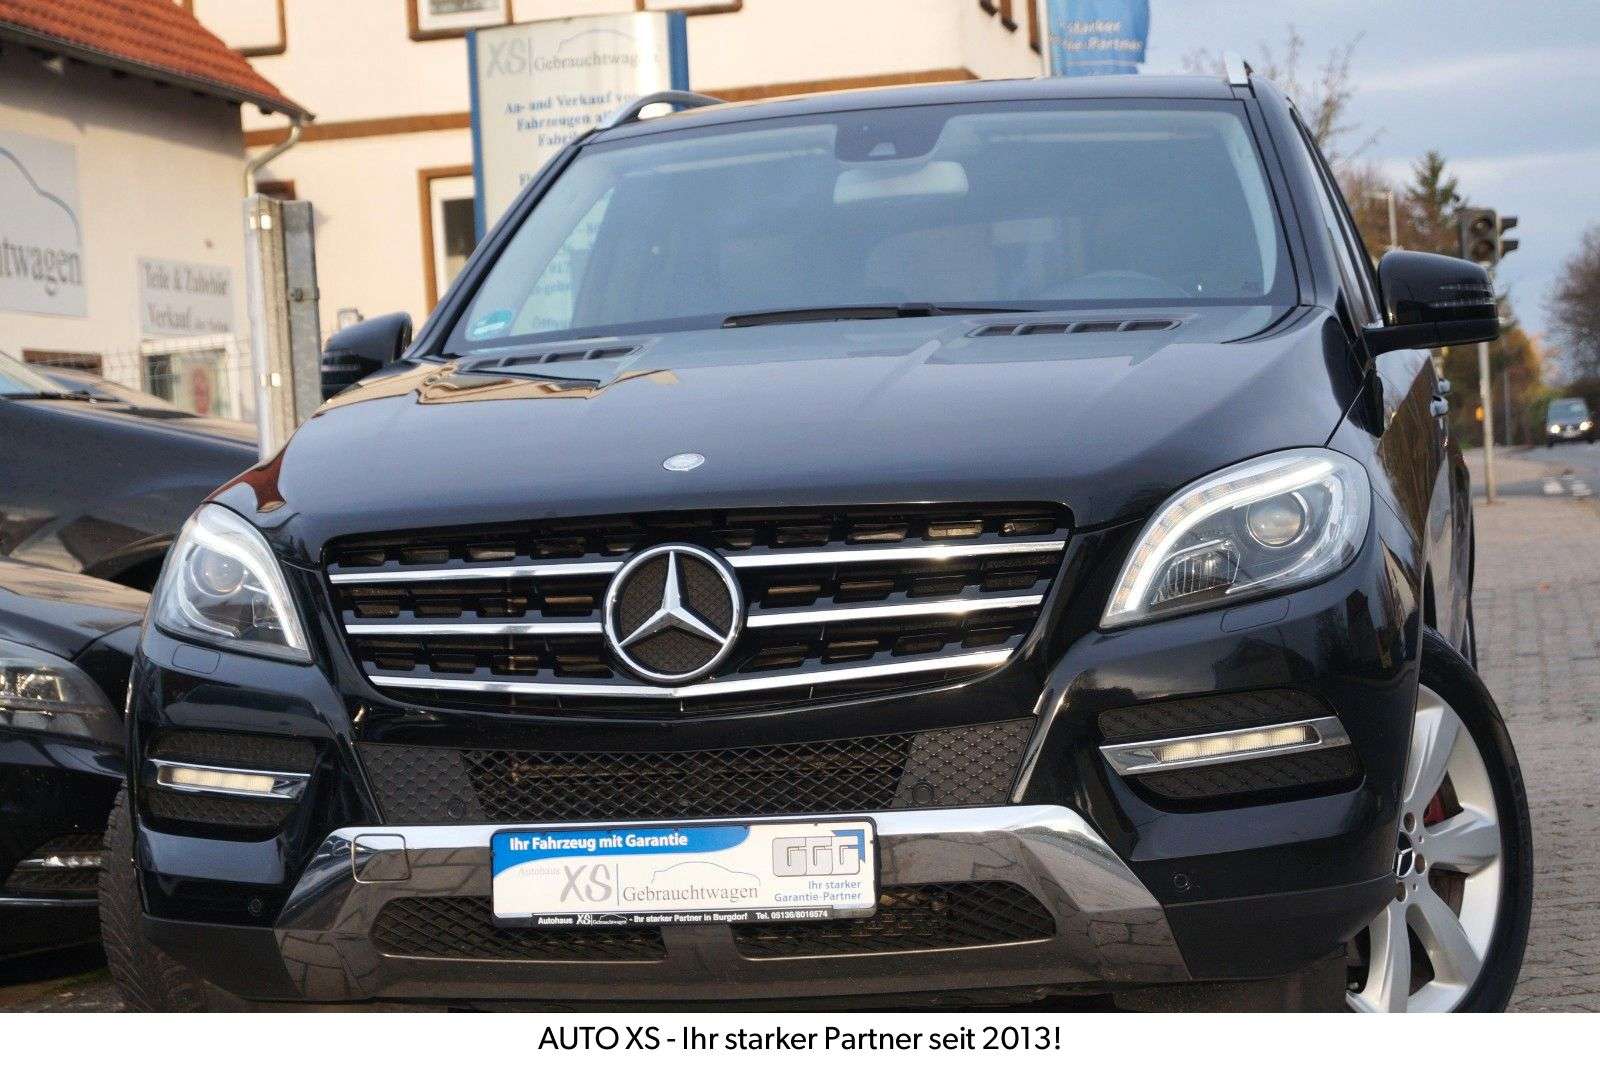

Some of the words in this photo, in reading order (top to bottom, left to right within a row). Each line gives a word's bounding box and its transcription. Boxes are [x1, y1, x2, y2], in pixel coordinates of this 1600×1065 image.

[486, 37, 527, 78] XS
[529, 97, 552, 110] und
[557, 92, 612, 106] Verkauf
[517, 113, 591, 131] Fahrzeugen
[509, 837, 529, 850] Ihr
[532, 835, 596, 851] Fahrzeug
[599, 834, 623, 848] mit
[625, 832, 688, 847] Garantie
[560, 863, 613, 903] XS
[809, 881, 822, 889] Ihr
[825, 880, 861, 889] starker
[623, 886, 759, 902] Gebrauchtwagen
[774, 892, 862, 902] Garantie-Partner
[537, 917, 574, 925] Autohaus
[576, 913, 591, 925] XS
[713, 912, 748, 922] Burgdorf
